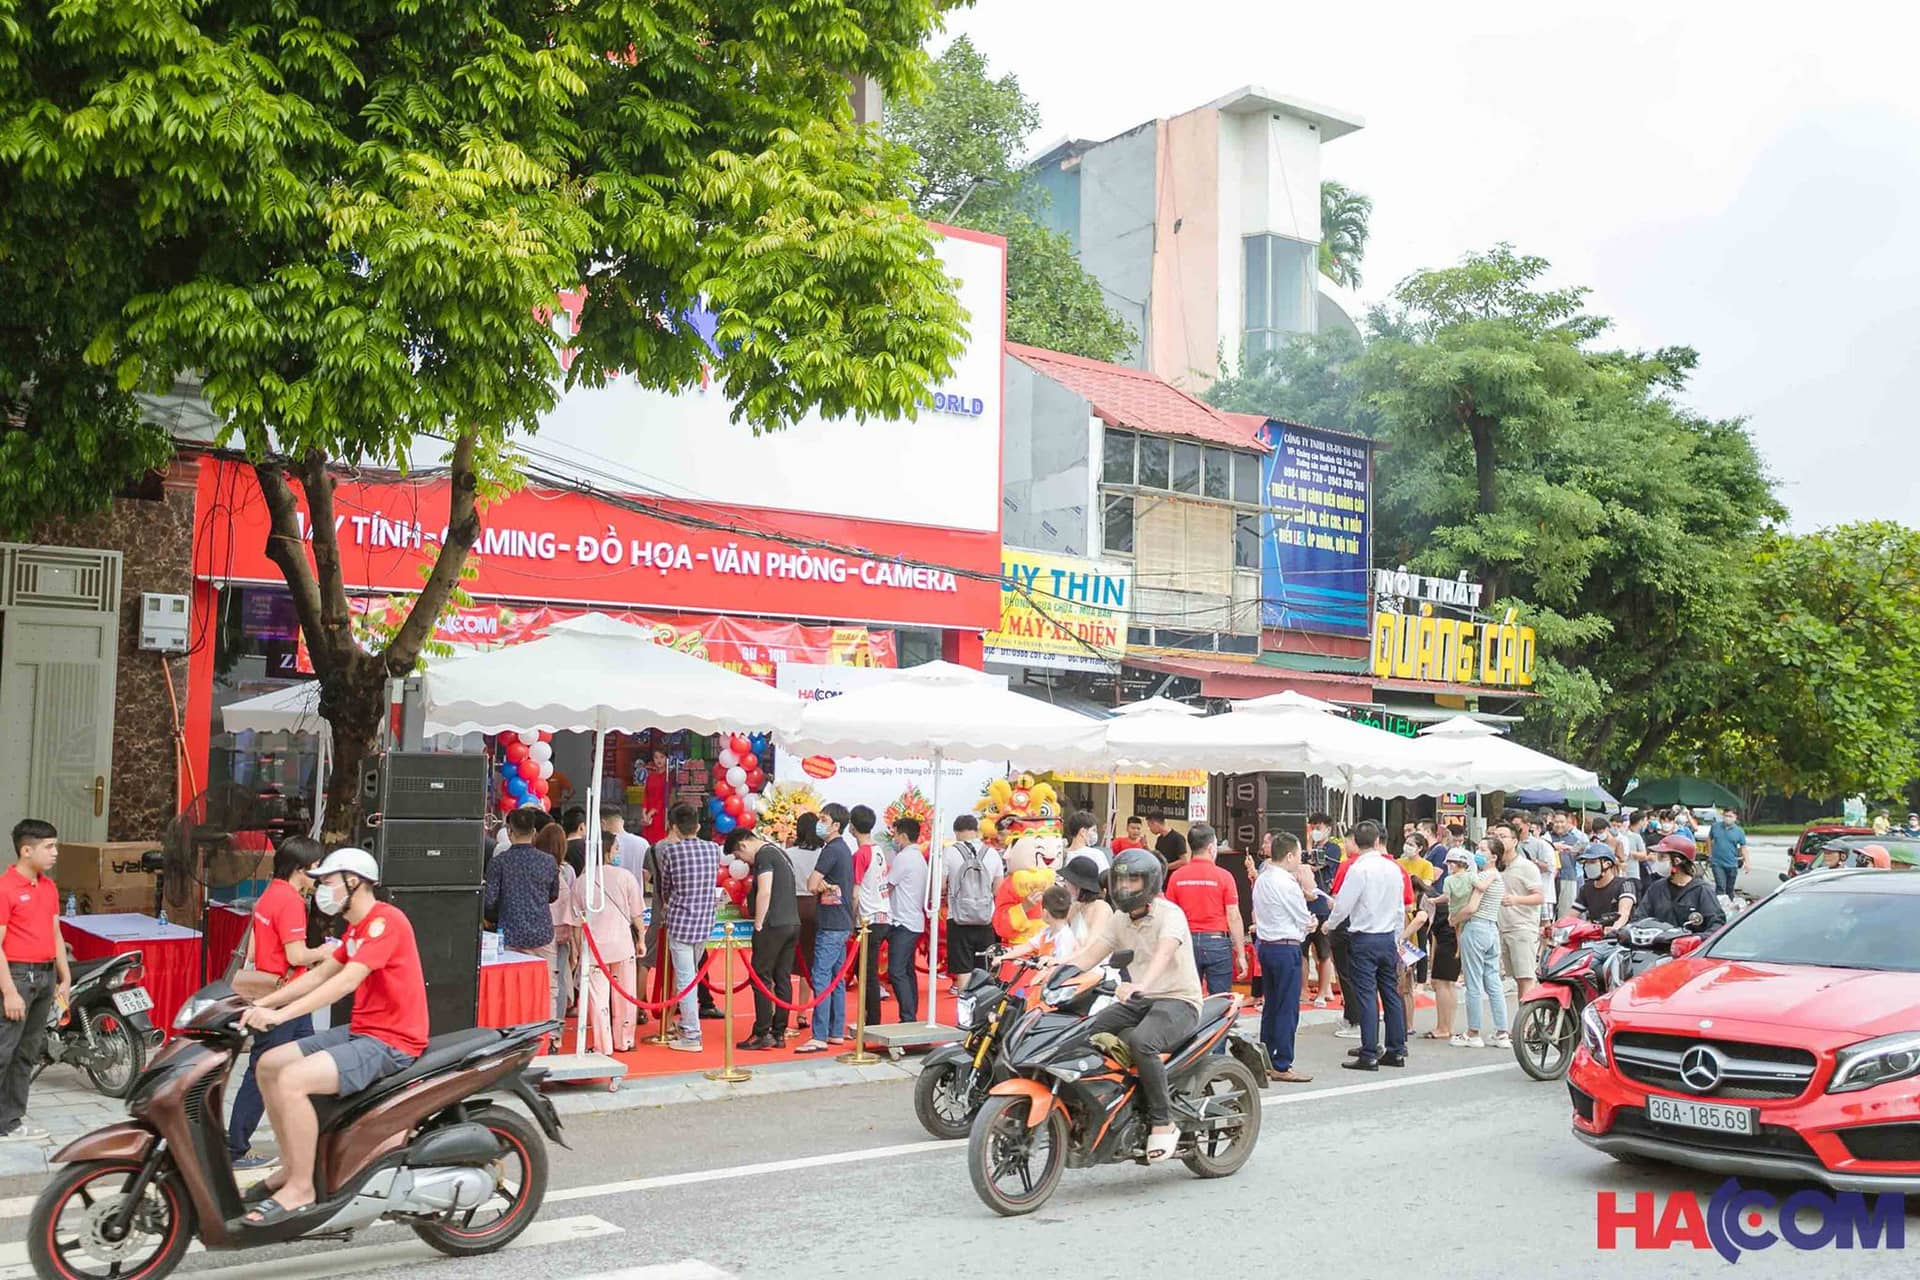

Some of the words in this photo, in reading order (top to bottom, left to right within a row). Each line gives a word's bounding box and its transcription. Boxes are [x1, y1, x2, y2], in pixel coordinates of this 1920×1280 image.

[916, 391, 984, 416] ORLD
[351, 510, 422, 550] TÍNH
[441, 526, 555, 559] AMING
[576, 524, 622, 565] ĐỒ
[631, 540, 693, 576] HỌA
[711, 542, 760, 575] VĂN
[766, 549, 846, 583] PHÒNG
[860, 560, 957, 592] CAMERA
[1051, 567, 1125, 607] THÌN
[1426, 570, 1484, 607] THẤT
[1482, 607, 1536, 686] CÁO
[1651, 1099, 1748, 1131] 36A-185.69
